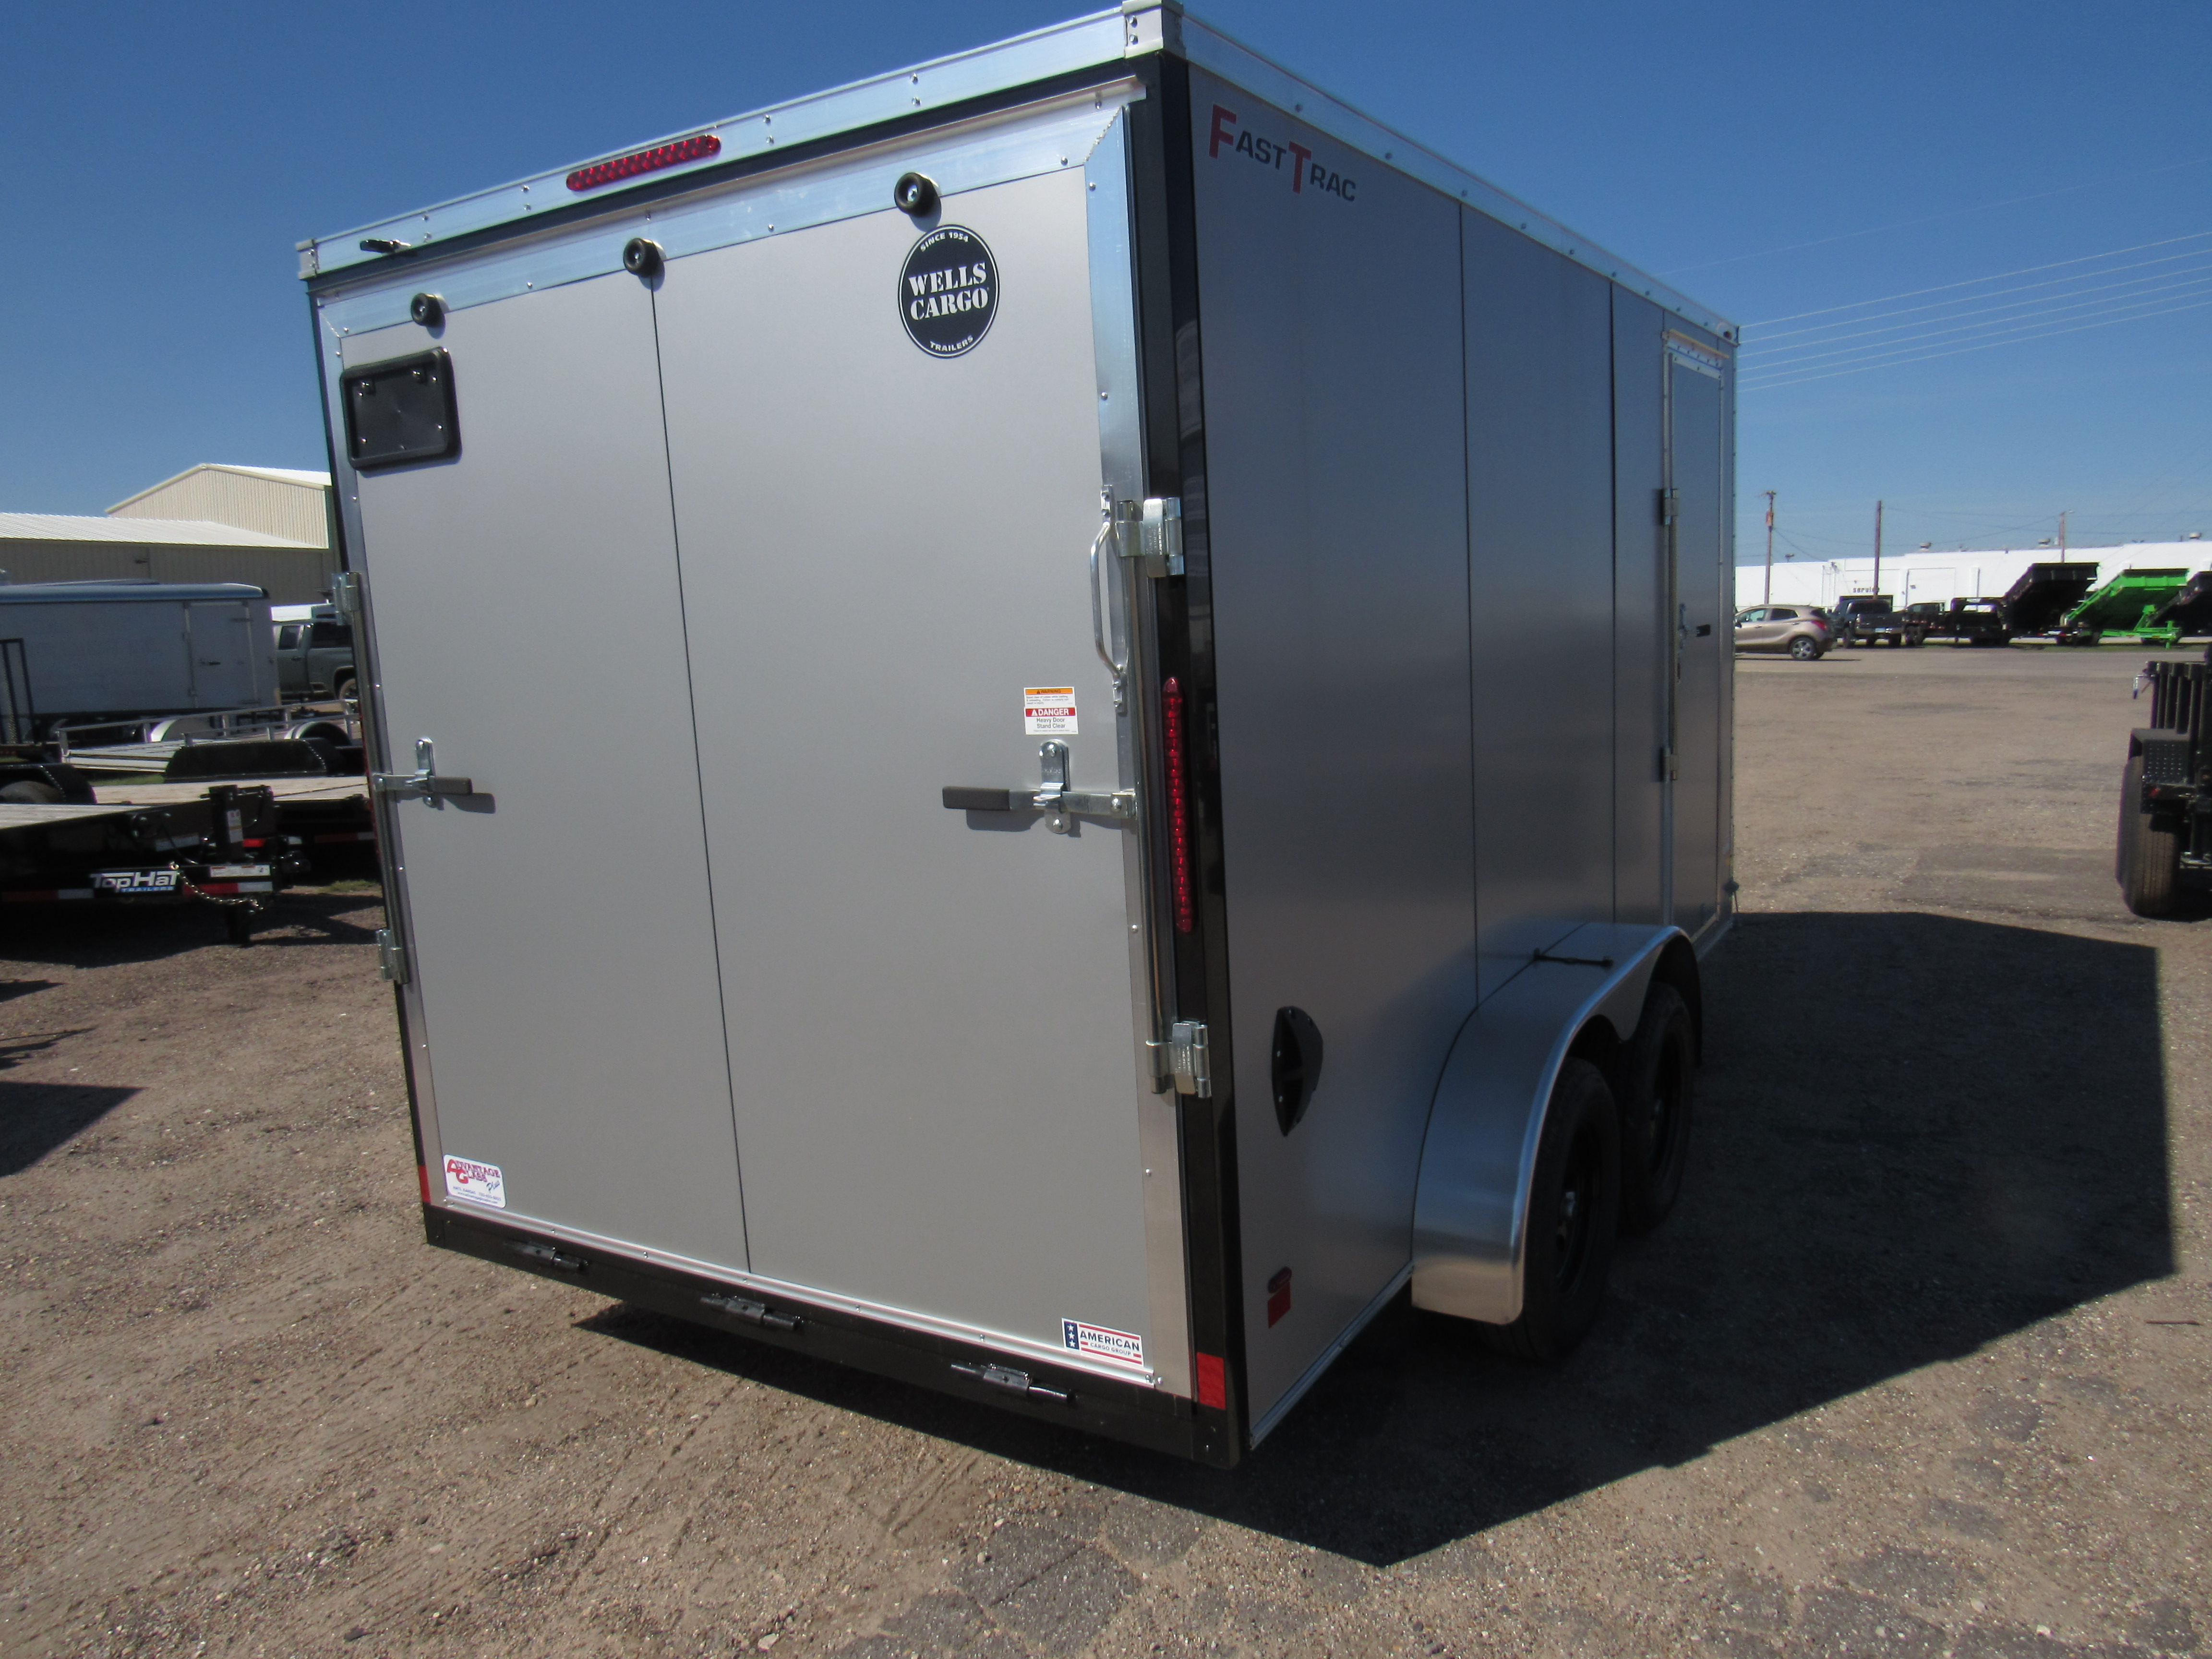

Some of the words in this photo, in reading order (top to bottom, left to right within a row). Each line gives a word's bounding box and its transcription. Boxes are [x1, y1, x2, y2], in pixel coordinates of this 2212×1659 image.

[920, 232, 946, 252] SINCE
[949, 231, 969, 242] 1954
[908, 262, 987, 296] WELLS
[910, 288, 988, 321] CARGO
[930, 335, 974, 352] TRAILERS
[1080, 1330, 1140, 1351] AMERICAN
[1090, 1342, 1110, 1351] CARGO
[1111, 1347, 1131, 1356] GROUP
